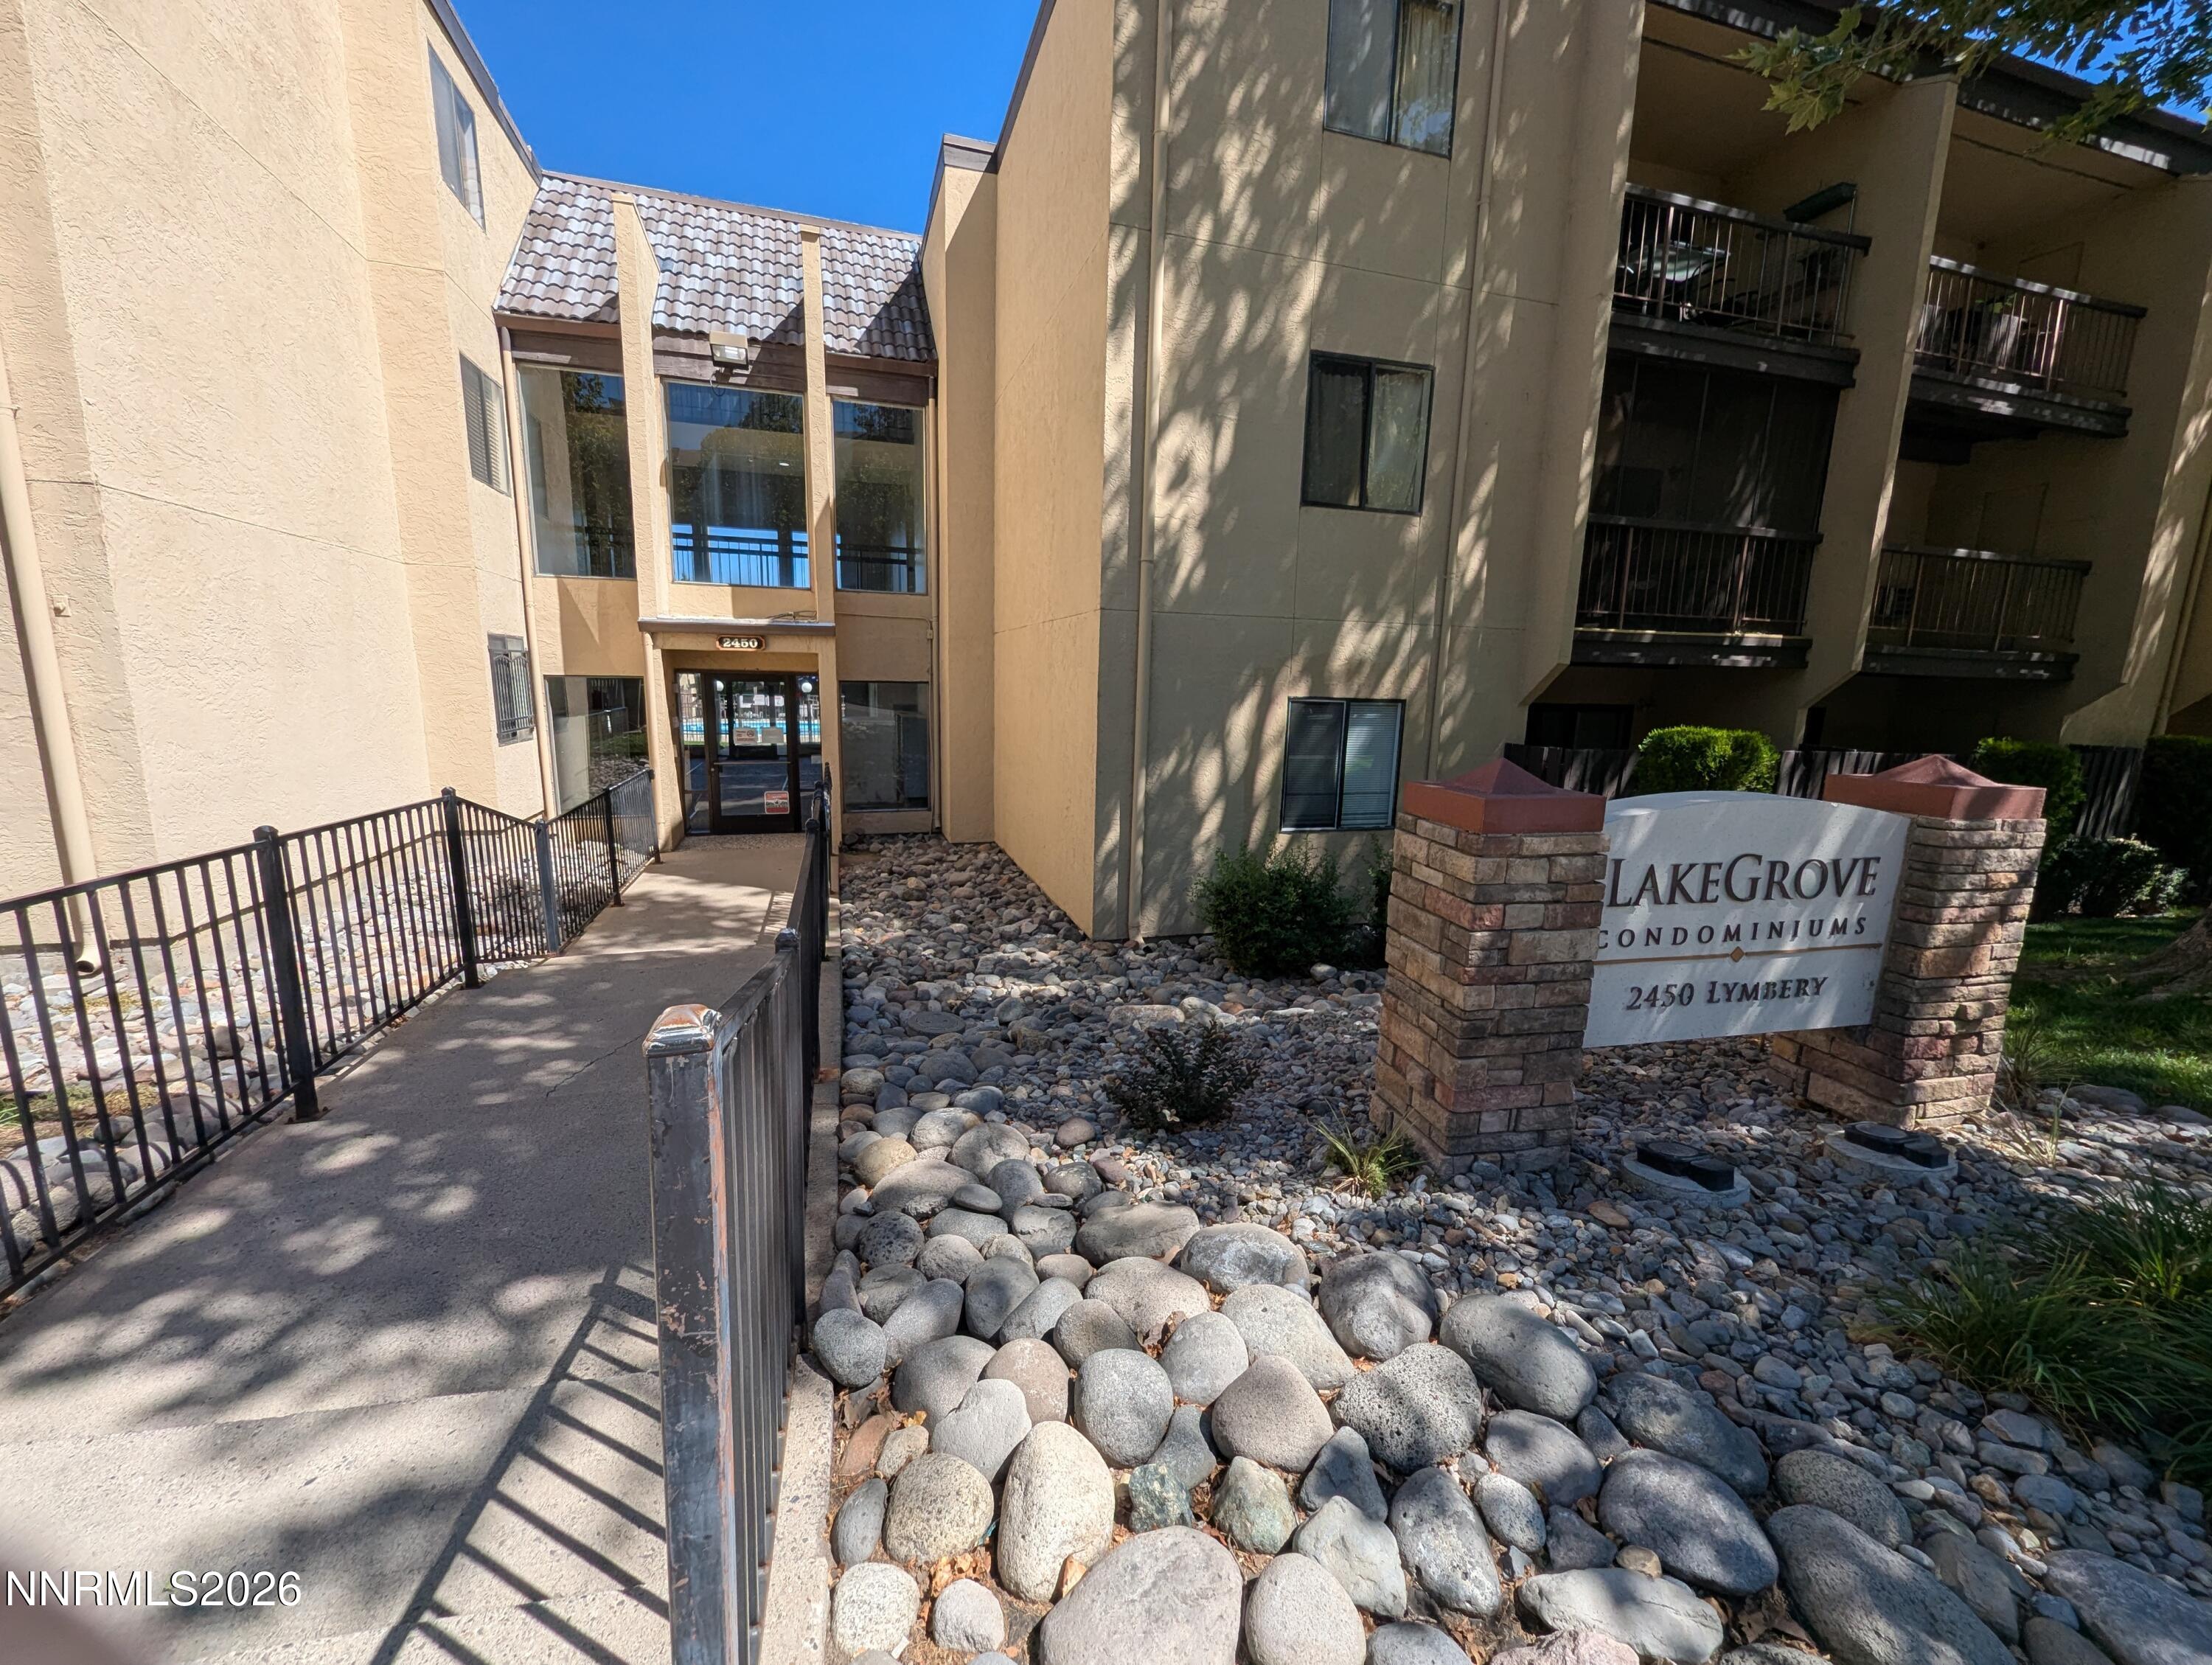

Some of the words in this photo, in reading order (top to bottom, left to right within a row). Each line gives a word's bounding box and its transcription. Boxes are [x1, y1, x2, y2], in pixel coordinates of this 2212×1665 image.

[723, 638, 758, 648] 2450
[1608, 854, 1880, 907] LAKEGROVE
[1599, 917, 1866, 949] CONDOMINIUMS
[1627, 983, 1694, 1009] 2450
[1708, 977, 1828, 1003] LYMBERY
